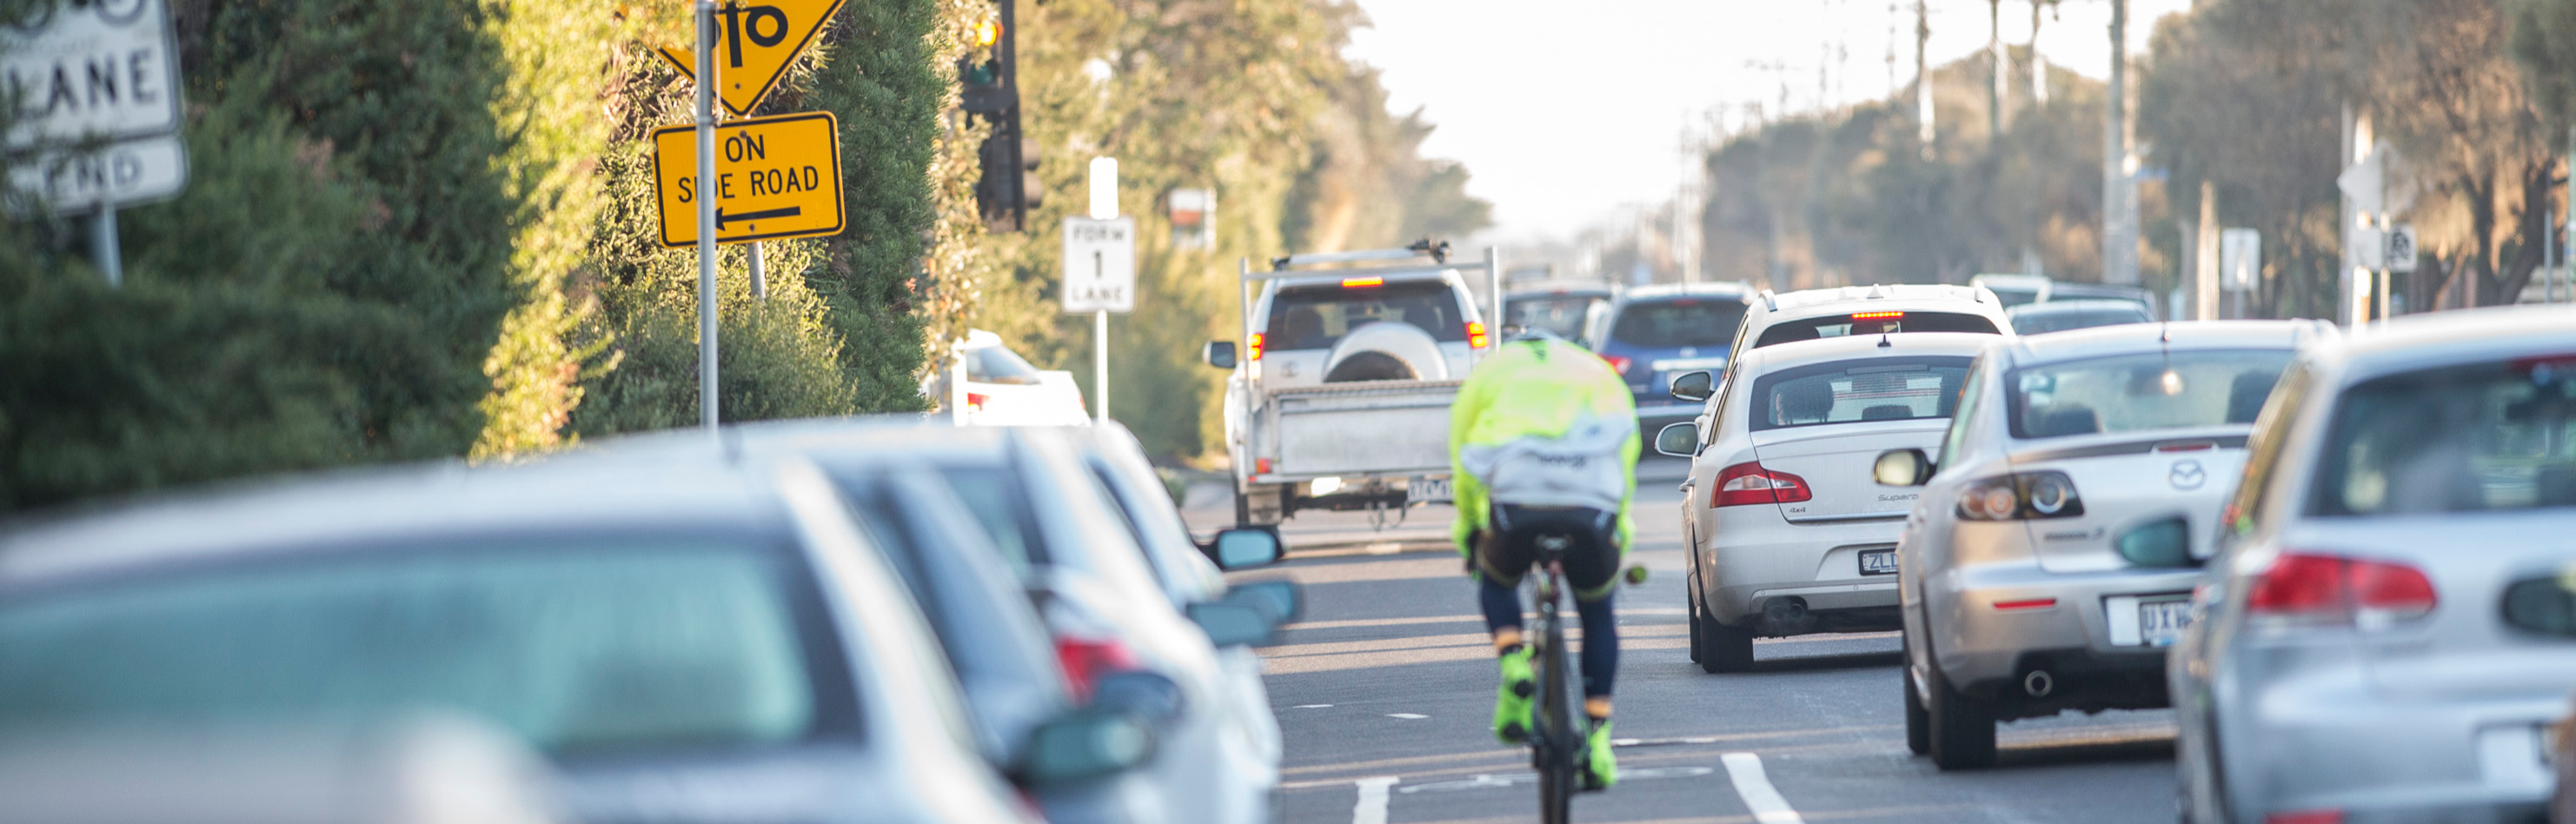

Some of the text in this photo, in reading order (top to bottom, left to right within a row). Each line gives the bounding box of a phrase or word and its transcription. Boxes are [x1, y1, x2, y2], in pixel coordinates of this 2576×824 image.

[9, 46, 159, 118] LANE
[725, 134, 766, 163] ON
[678, 165, 819, 203] SIE ROAD
[1092, 249, 1102, 279] 1
[1071, 285, 1124, 303] LANE
[1877, 494, 1920, 502] Superb
